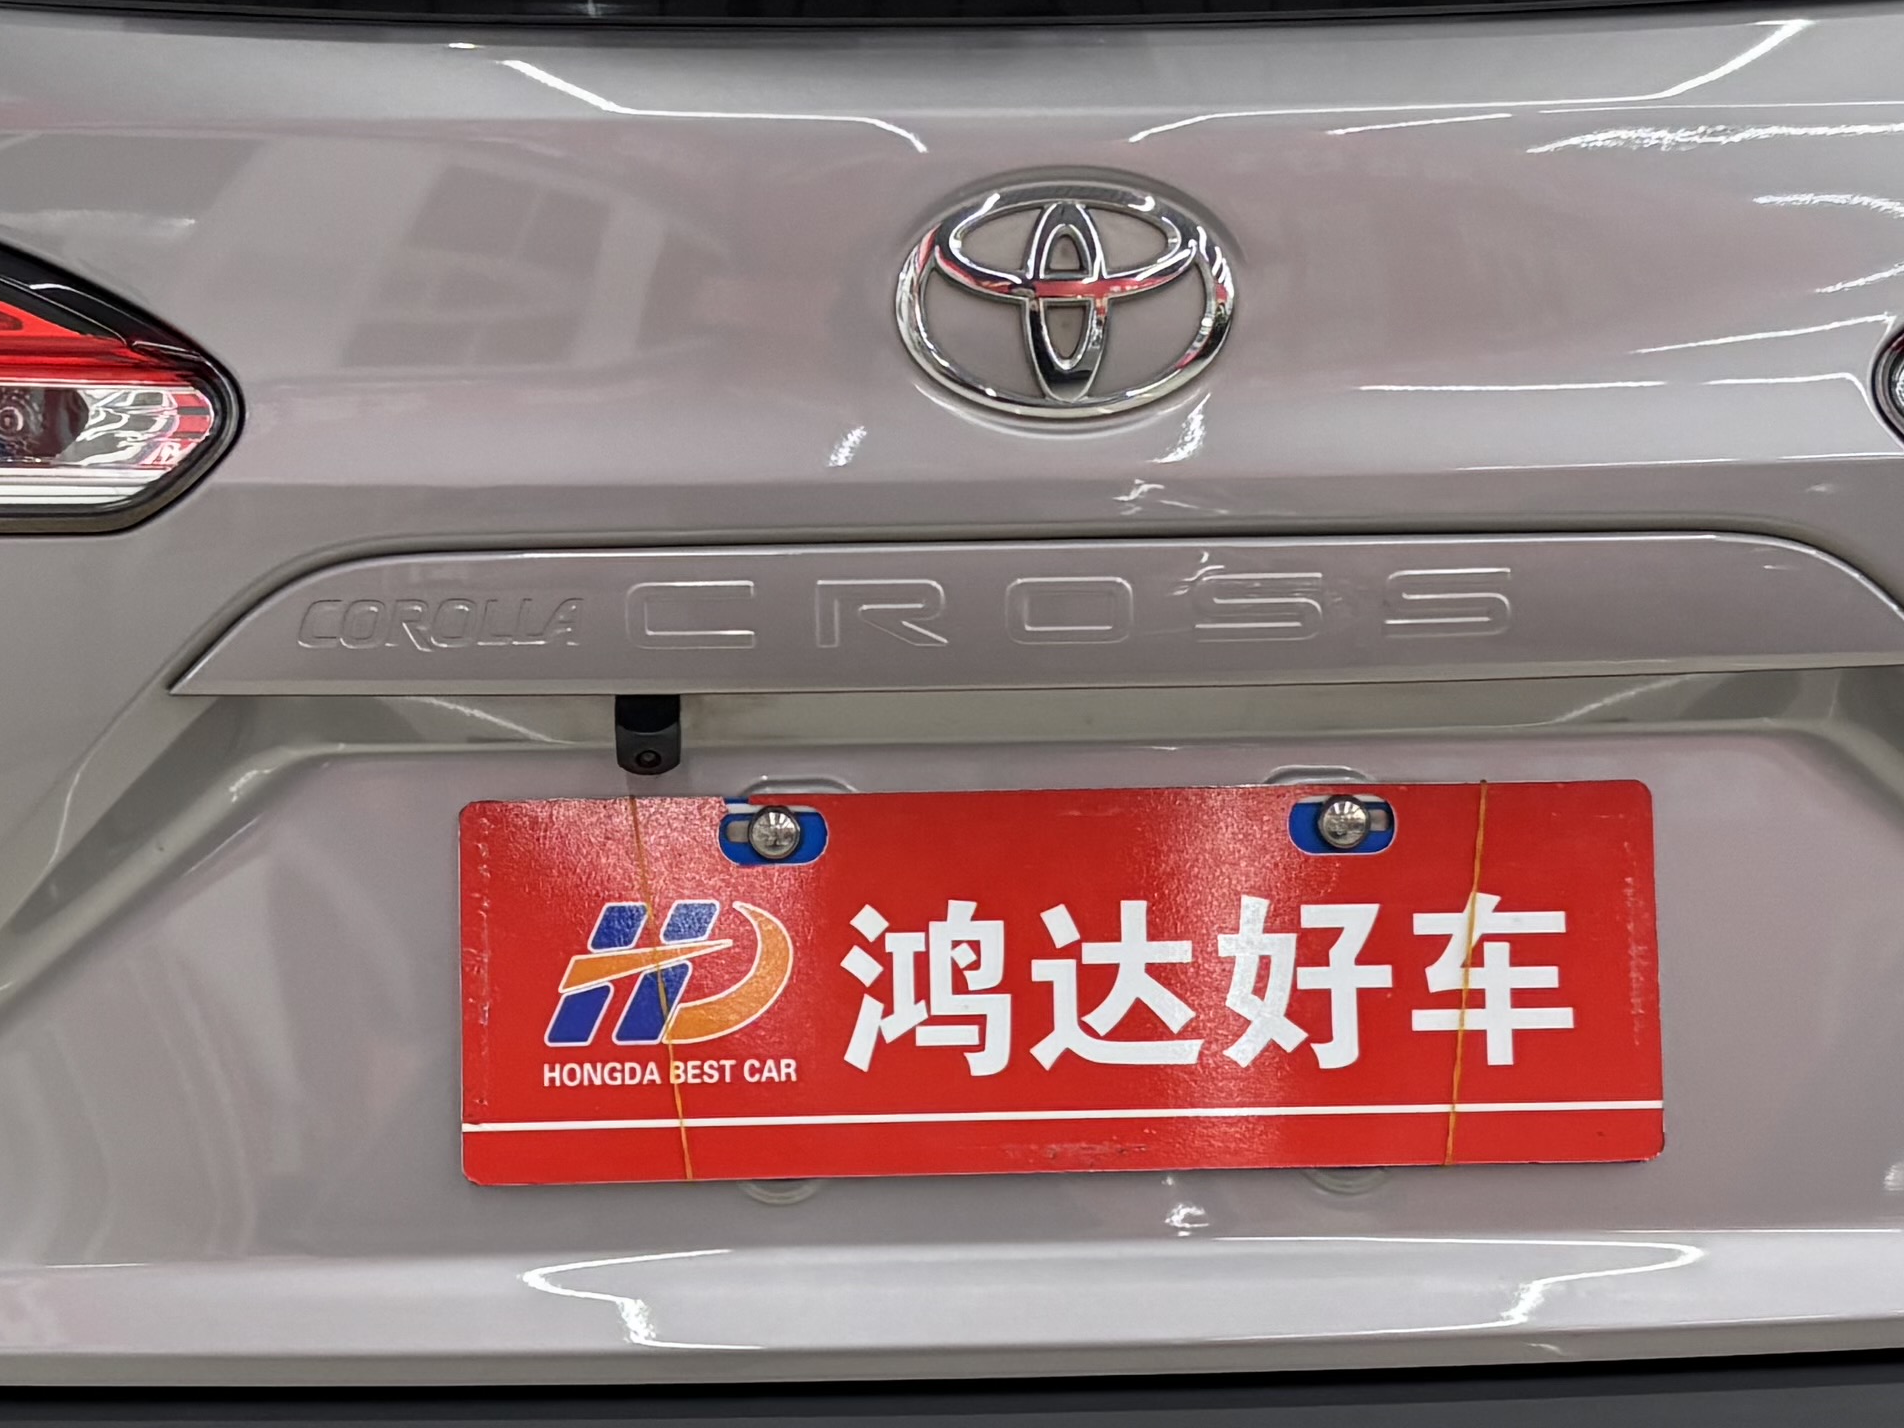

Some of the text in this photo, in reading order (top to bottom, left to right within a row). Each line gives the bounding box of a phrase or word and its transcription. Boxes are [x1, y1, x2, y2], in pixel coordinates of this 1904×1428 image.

[295, 565, 1513, 653] COROLLA CROSS
[838, 892, 1575, 1078] 鸿达好车
[542, 1057, 798, 1088] HONGDA BEST CAR
